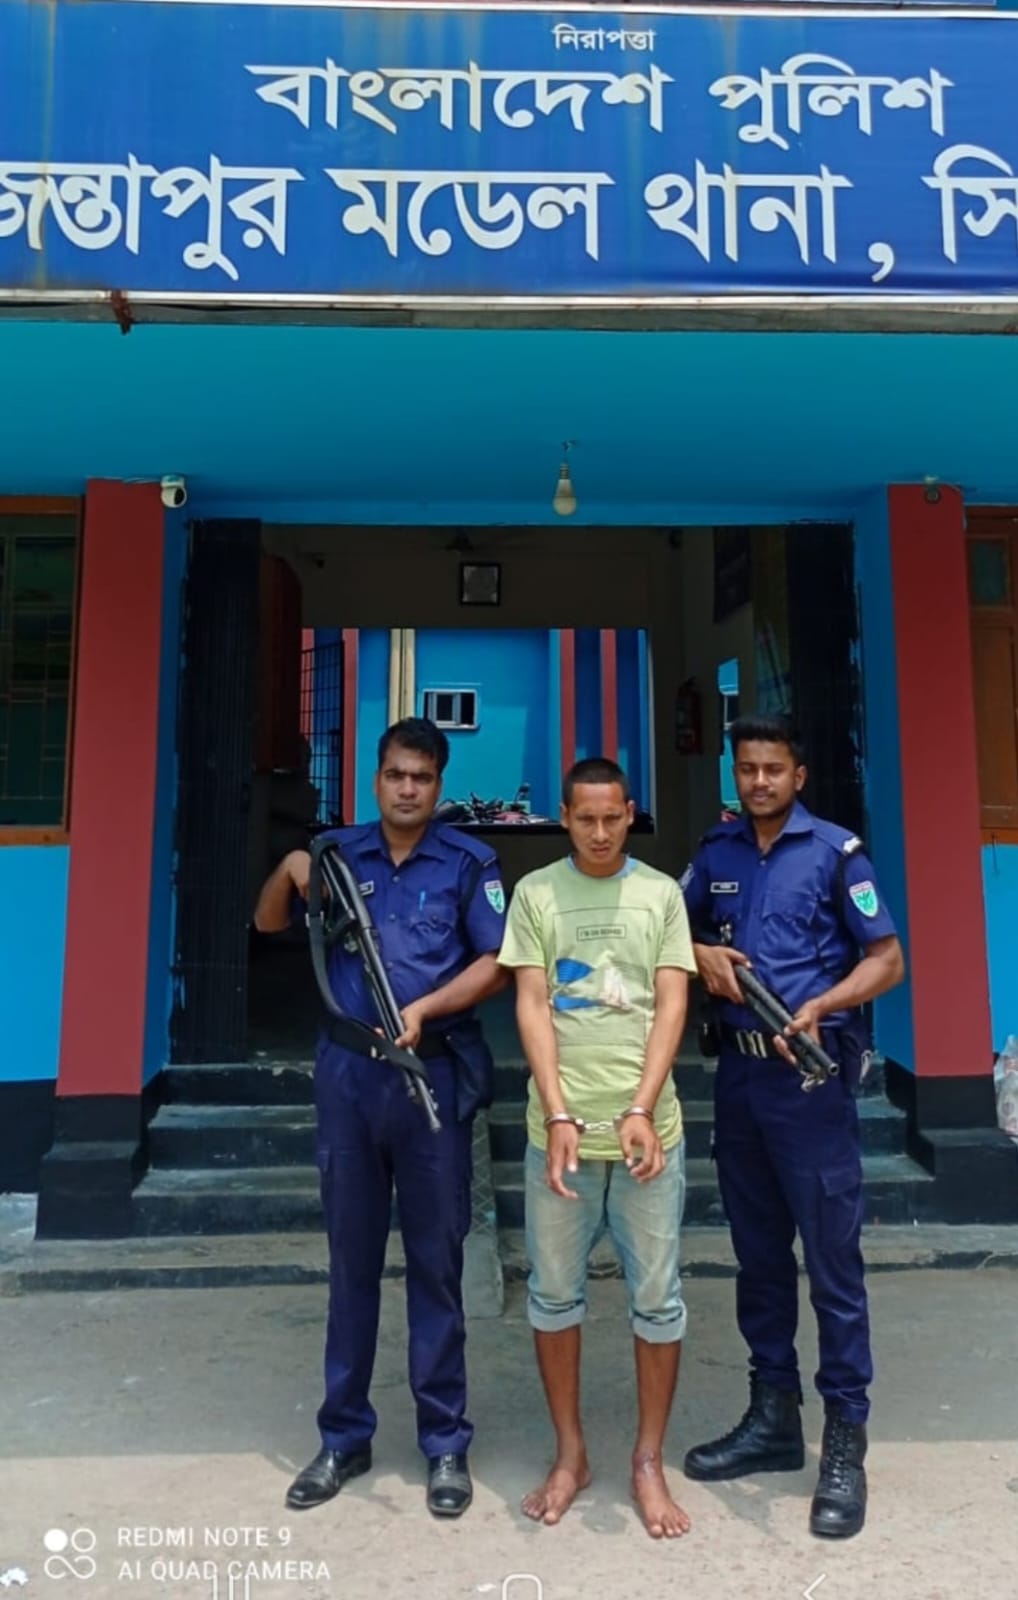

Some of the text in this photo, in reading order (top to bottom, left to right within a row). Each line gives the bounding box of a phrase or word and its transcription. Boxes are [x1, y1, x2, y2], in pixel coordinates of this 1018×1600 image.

[550, 23, 656, 51] নিরাপত্তা
[244, 53, 956, 151] বাংলাদেশ পুলিশ
[0, 153, 305, 281] জন্তাপুর
[324, 168, 616, 261] মডেল
[920, 143, 1018, 264] সি
